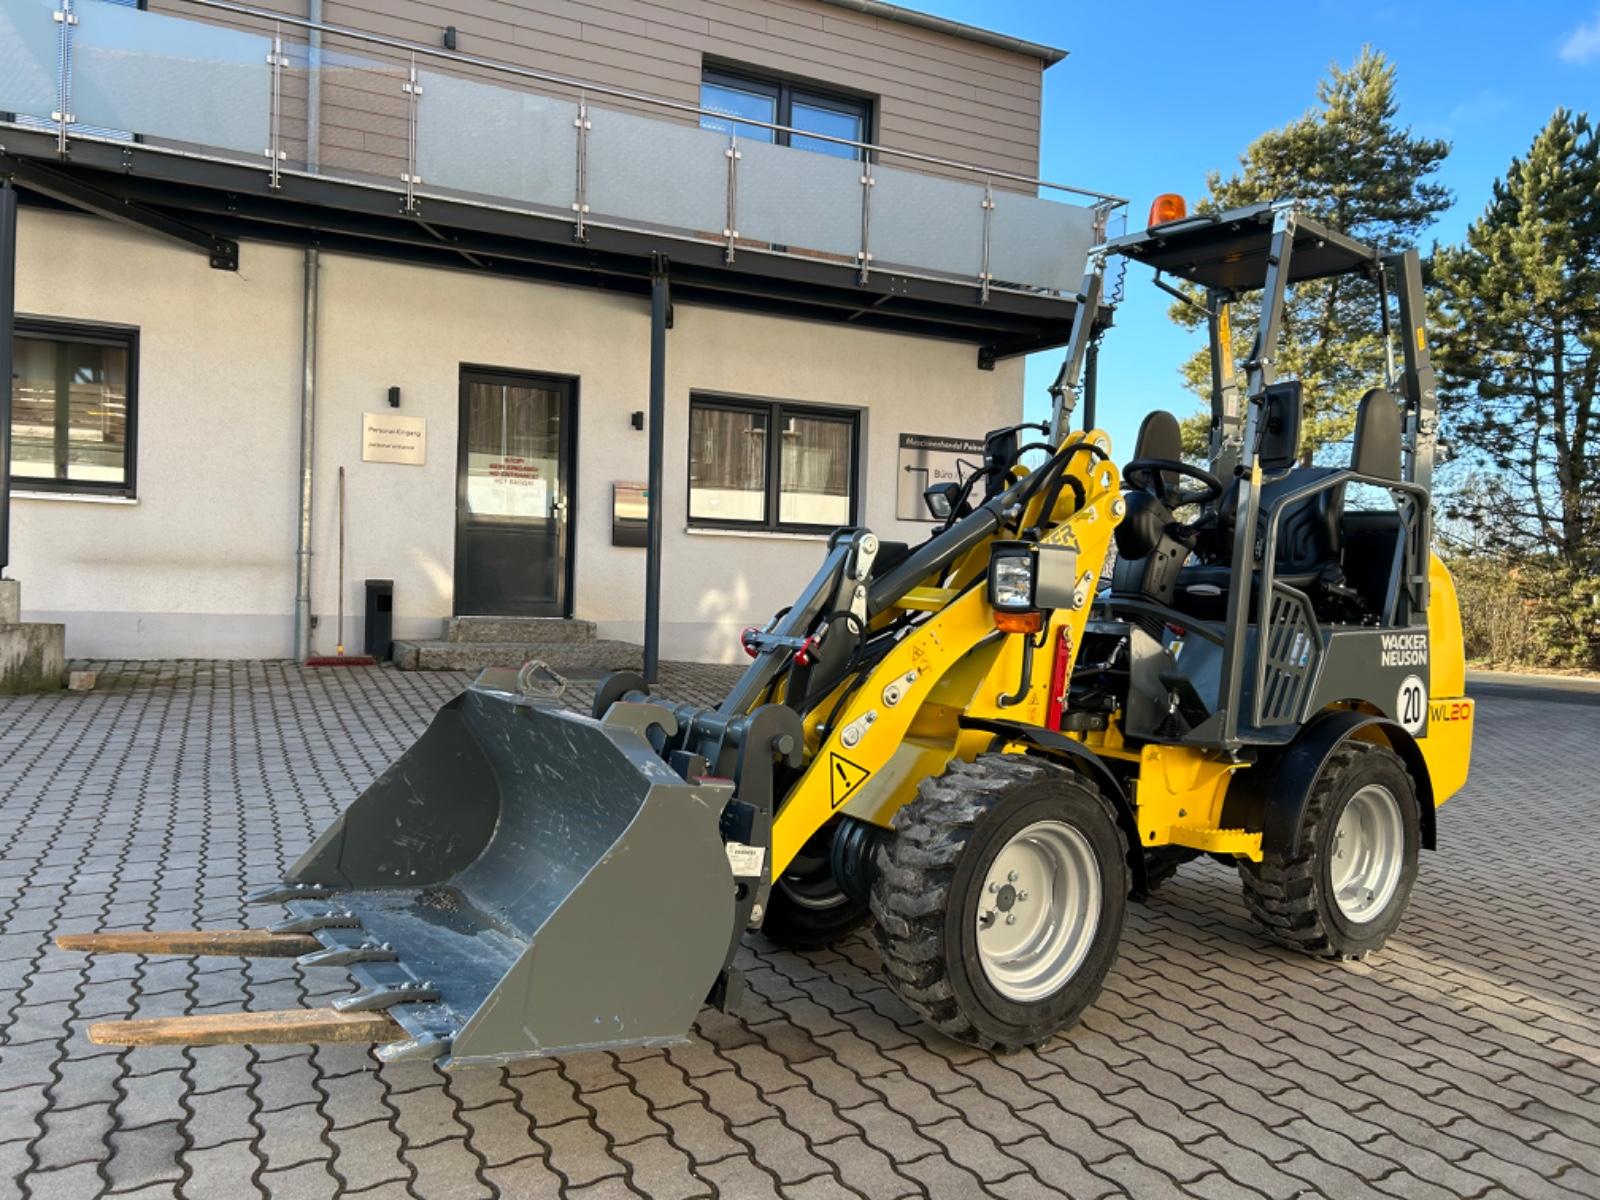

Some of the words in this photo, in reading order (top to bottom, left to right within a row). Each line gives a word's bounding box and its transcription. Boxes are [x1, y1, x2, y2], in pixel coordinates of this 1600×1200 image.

[934, 468, 953, 479] Büro
[1381, 634, 1428, 650] WACKER
[1381, 650, 1428, 667] NEUSON
[1403, 686, 1421, 724] 20
[1430, 703, 1471, 722] WL20
